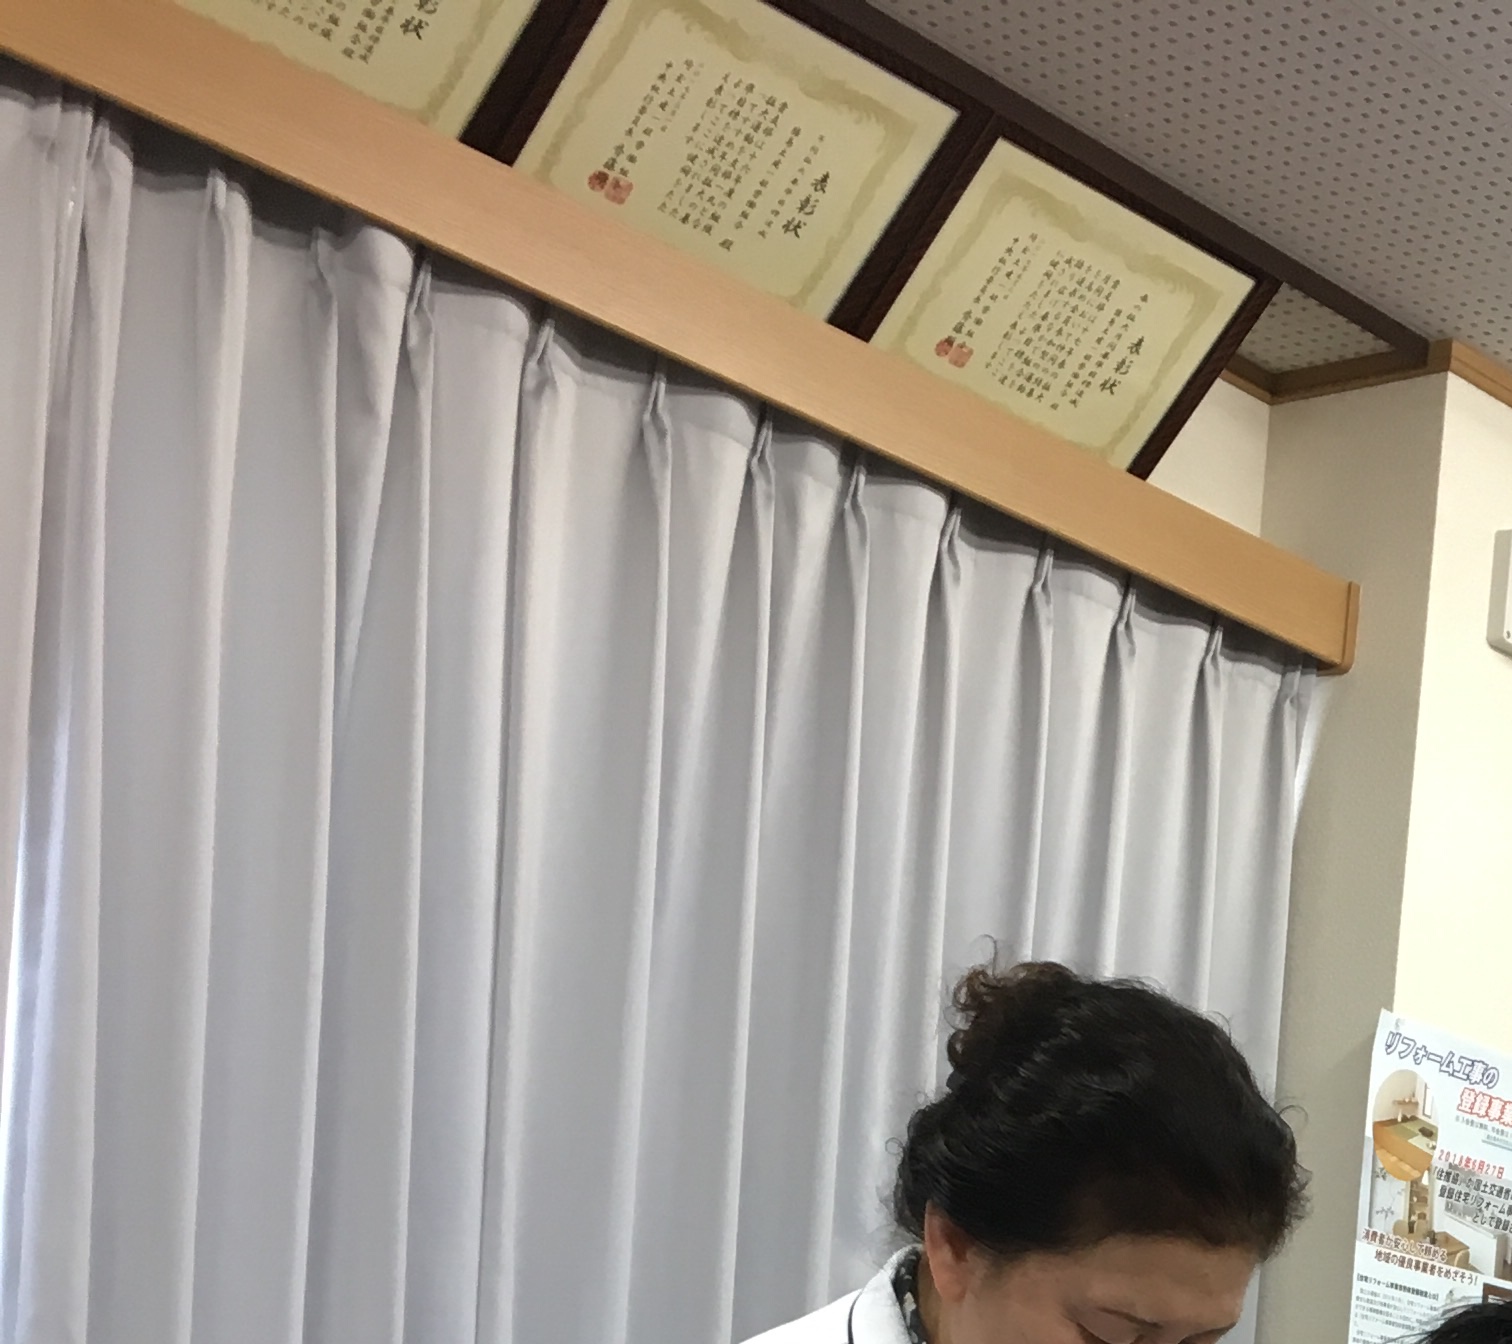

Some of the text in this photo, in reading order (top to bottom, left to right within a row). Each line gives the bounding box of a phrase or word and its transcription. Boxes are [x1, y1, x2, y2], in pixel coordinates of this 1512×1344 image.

[782, 170, 830, 239] 表彰状
[1098, 336, 1146, 396] 表彰状
[1385, 1030, 1500, 1090] リフォーム工事の
[1362, 1227, 1448, 1263] 消費者が安心して頼める
